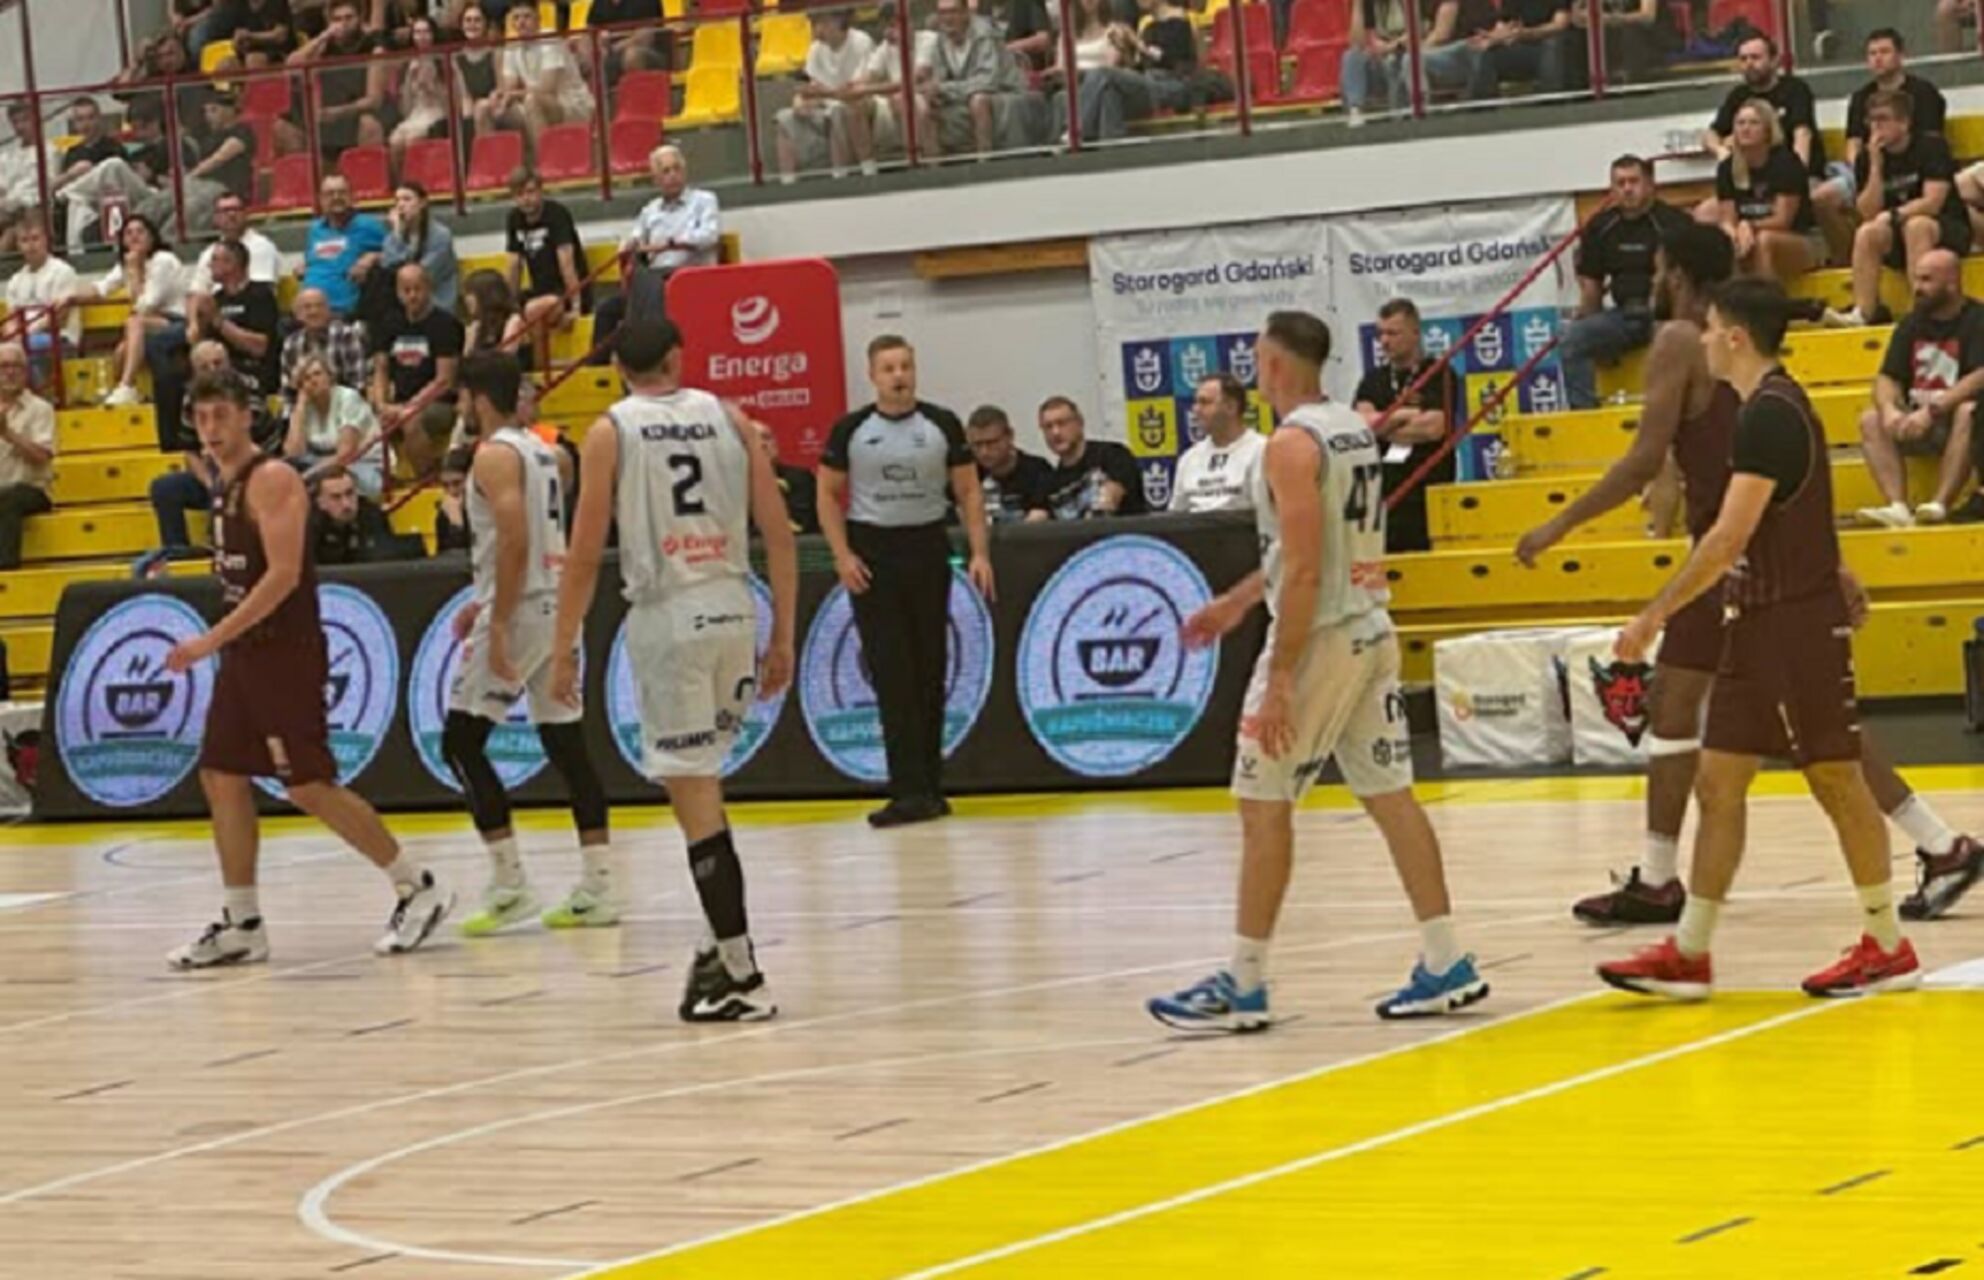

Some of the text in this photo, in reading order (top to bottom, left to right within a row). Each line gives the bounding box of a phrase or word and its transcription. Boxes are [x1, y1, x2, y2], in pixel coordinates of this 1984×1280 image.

[1113, 255, 1313, 295] Starogard Gdański
[1350, 245, 1462, 276] Starogard
[708, 351, 808, 382] Energa
[669, 454, 706, 517] 2
[1344, 463, 1383, 533] 47
[1090, 646, 1146, 673] BAR
[114, 693, 162, 717] BAR
